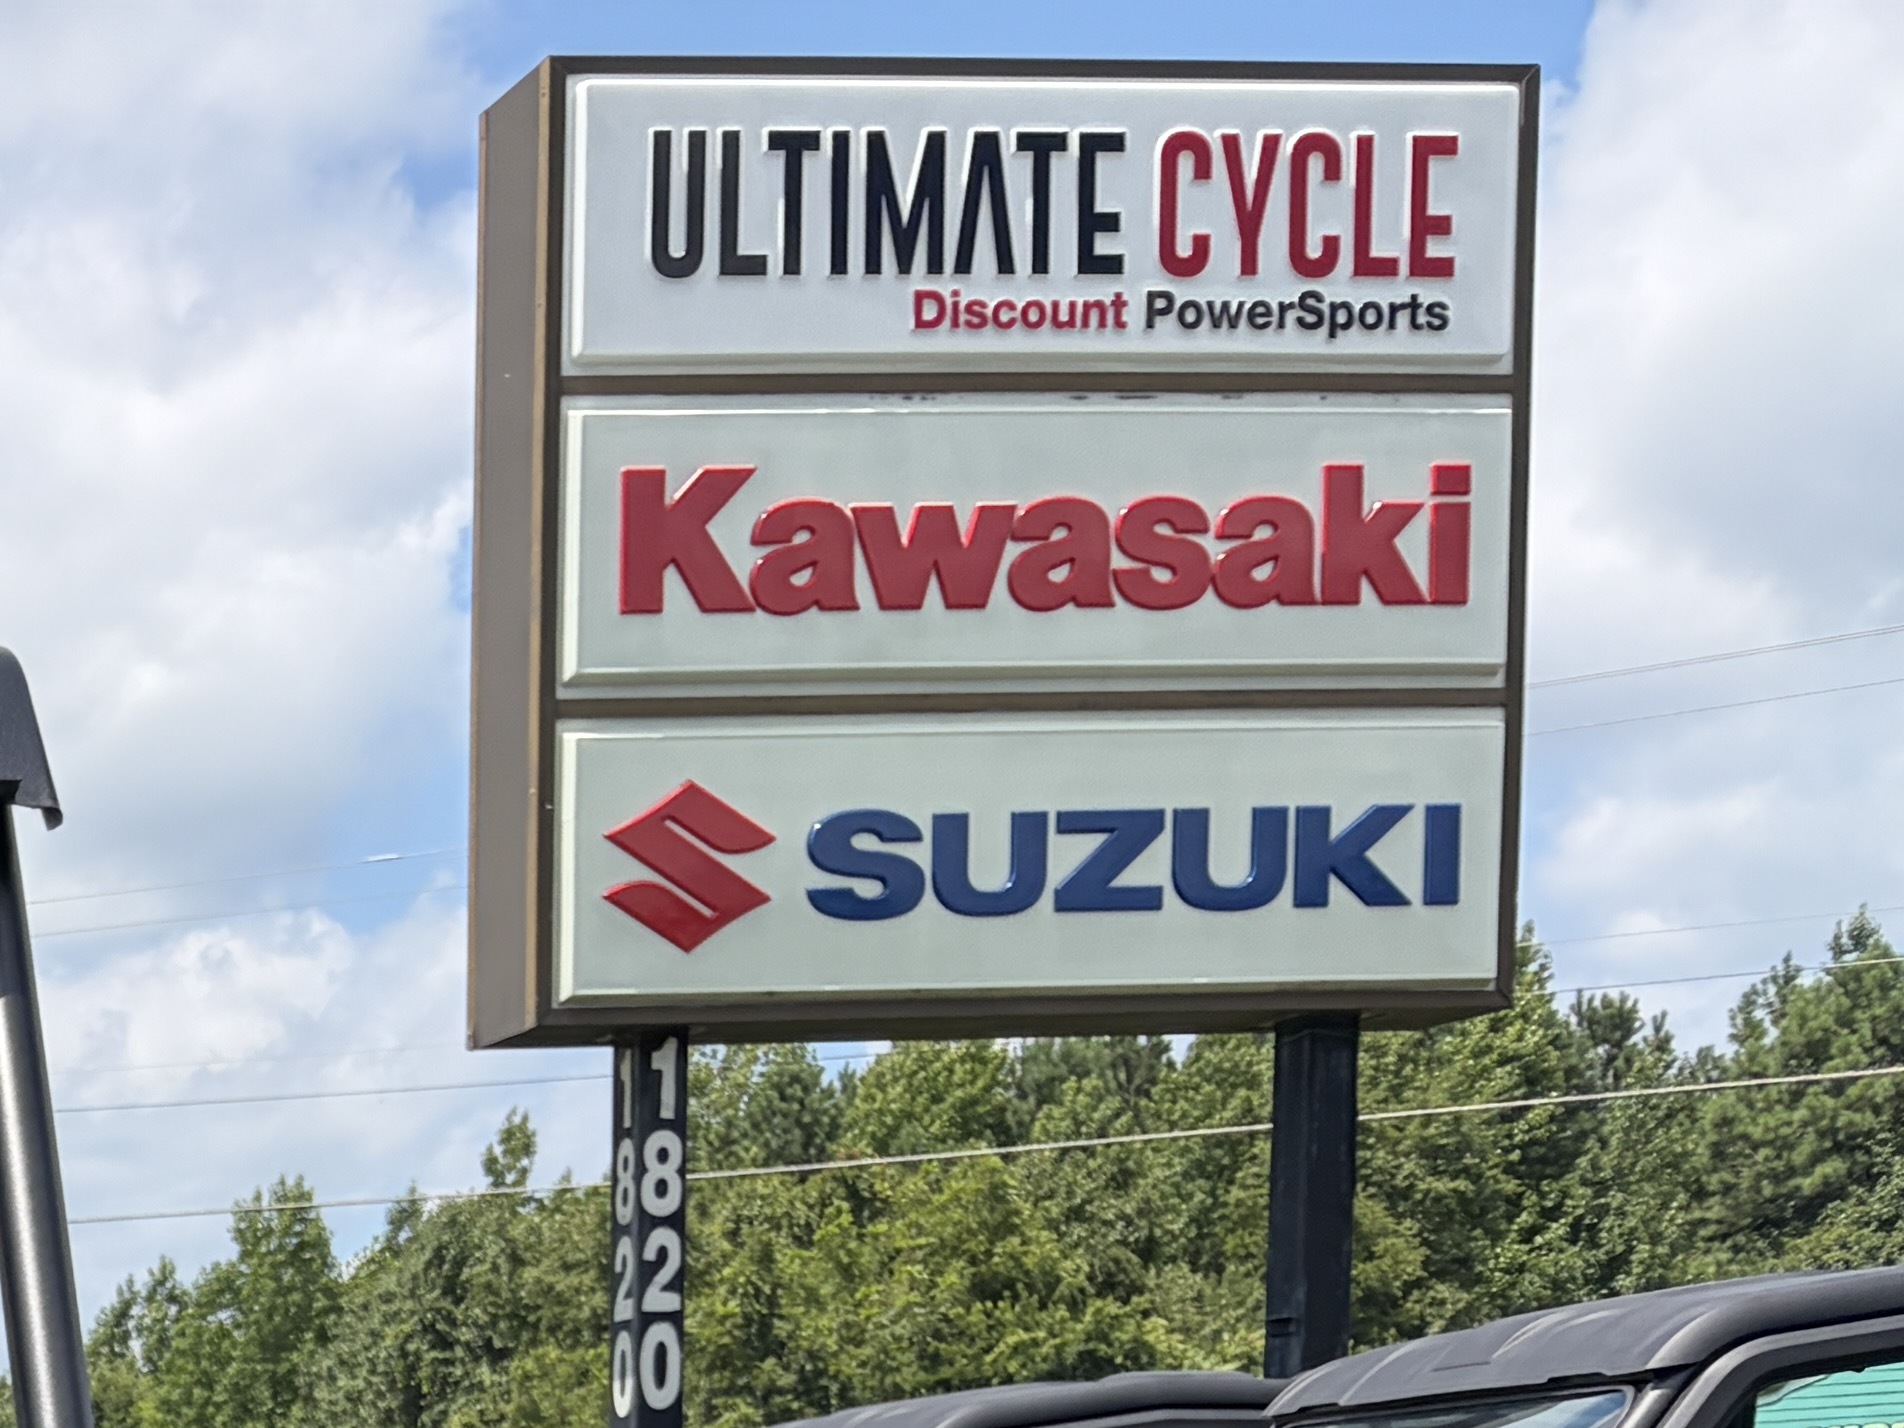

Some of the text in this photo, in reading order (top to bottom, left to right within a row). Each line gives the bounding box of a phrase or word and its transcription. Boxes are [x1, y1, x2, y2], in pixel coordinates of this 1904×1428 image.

[648, 127, 1460, 279] ULTIMATE CYCLE
[912, 289, 1450, 339] Discount PowerSports
[618, 462, 1472, 616] Kawasaki
[804, 801, 1462, 921] SUZUKI
[639, 1036, 683, 1410] 1820
